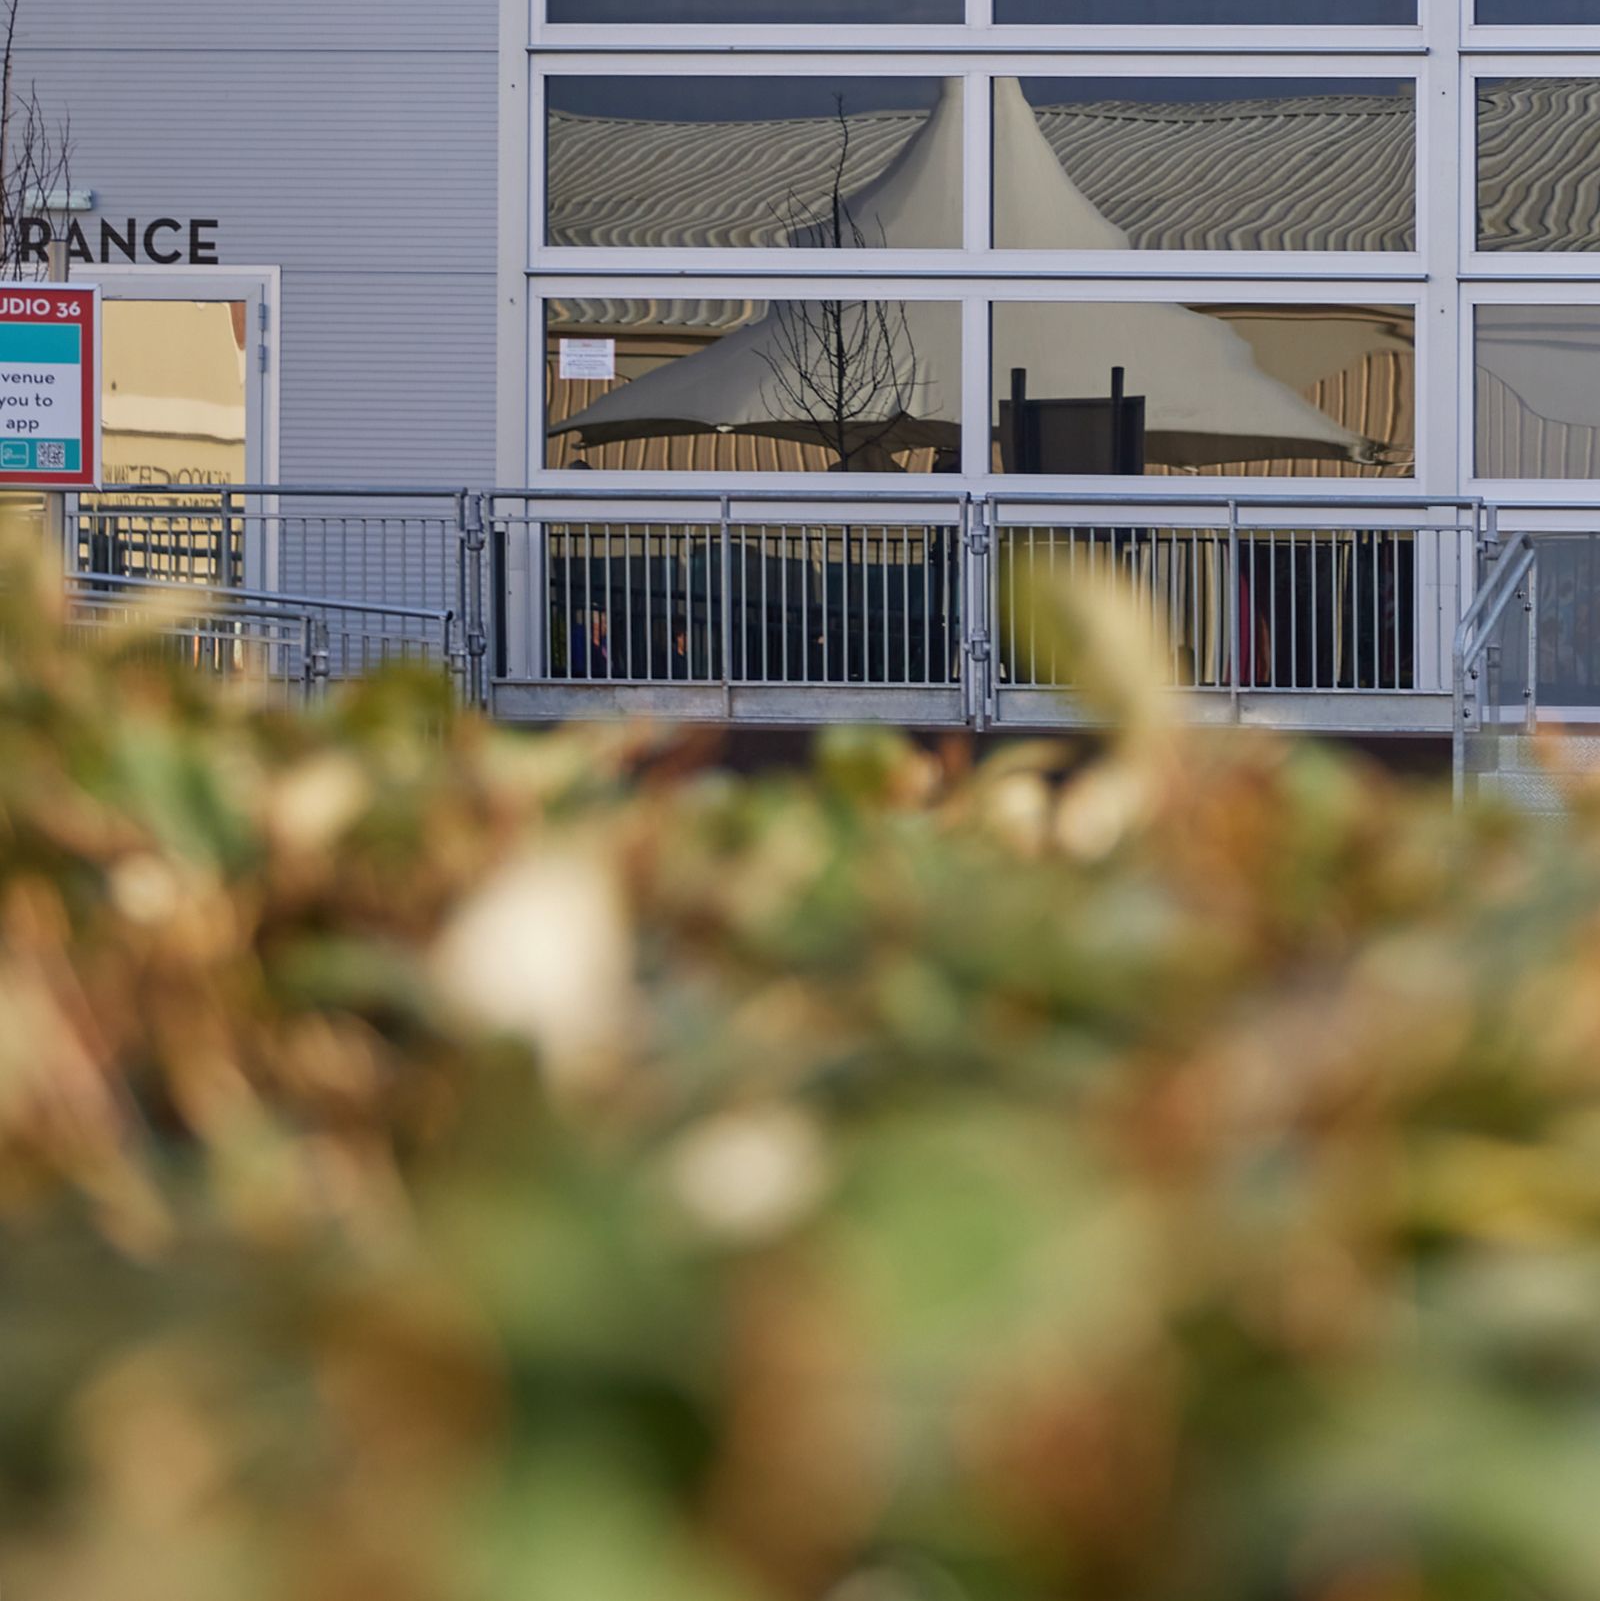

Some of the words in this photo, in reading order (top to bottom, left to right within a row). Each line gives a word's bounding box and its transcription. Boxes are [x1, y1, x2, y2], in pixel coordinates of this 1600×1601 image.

[56, 300, 82, 318] 36
[1, 373, 55, 385] venue
[35, 392, 53, 407] to
[6, 419, 40, 434] app
